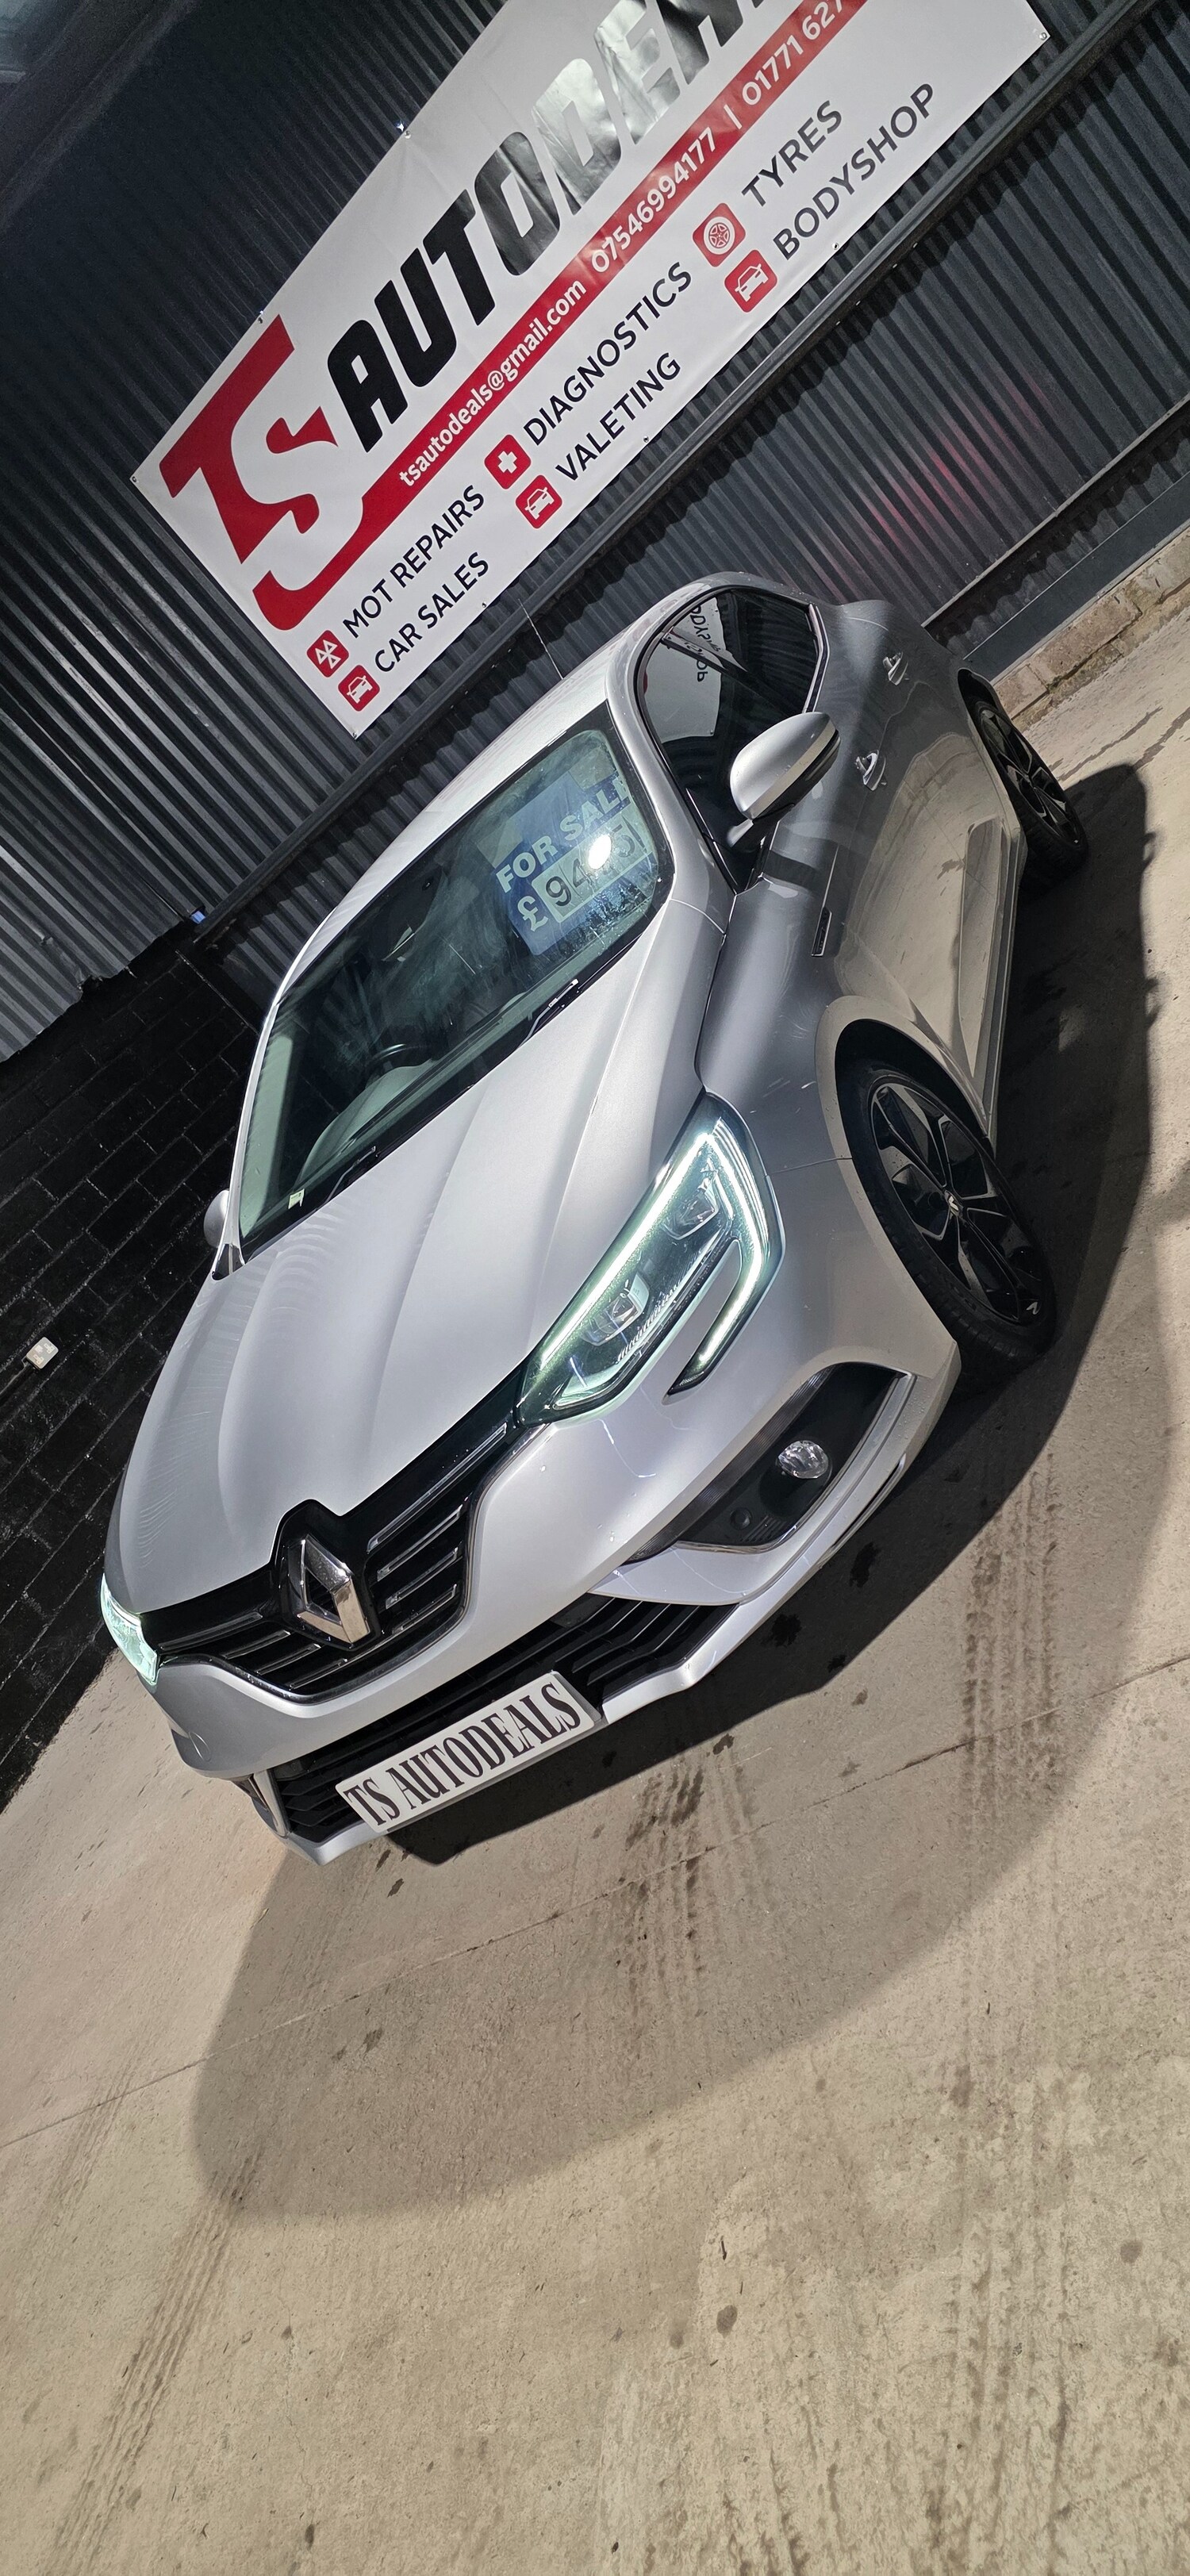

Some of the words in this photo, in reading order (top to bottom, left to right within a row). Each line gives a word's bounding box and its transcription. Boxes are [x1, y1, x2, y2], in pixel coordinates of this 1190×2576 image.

[742, 100, 843, 206] TYRES
[773, 83, 934, 260] BODYSHOP
[399, 280, 587, 486] tsautodeals@gmail.com
[590, 125, 716, 273] 07546994177
[741, 34, 804, 106] 01771
[523, 261, 692, 446] DIAGNOSTICS
[555, 352, 681, 481] VALETING
[159, 315, 367, 627] TS
[342, 578, 393, 639] MOT
[390, 485, 485, 588] REPAIRS
[374, 623, 423, 672] CAR
[417, 551, 489, 629] SALES
[496, 835, 558, 893] FOR
[343, 1777, 401, 1826] TS
[385, 1682, 582, 1810] AUTODEALS
